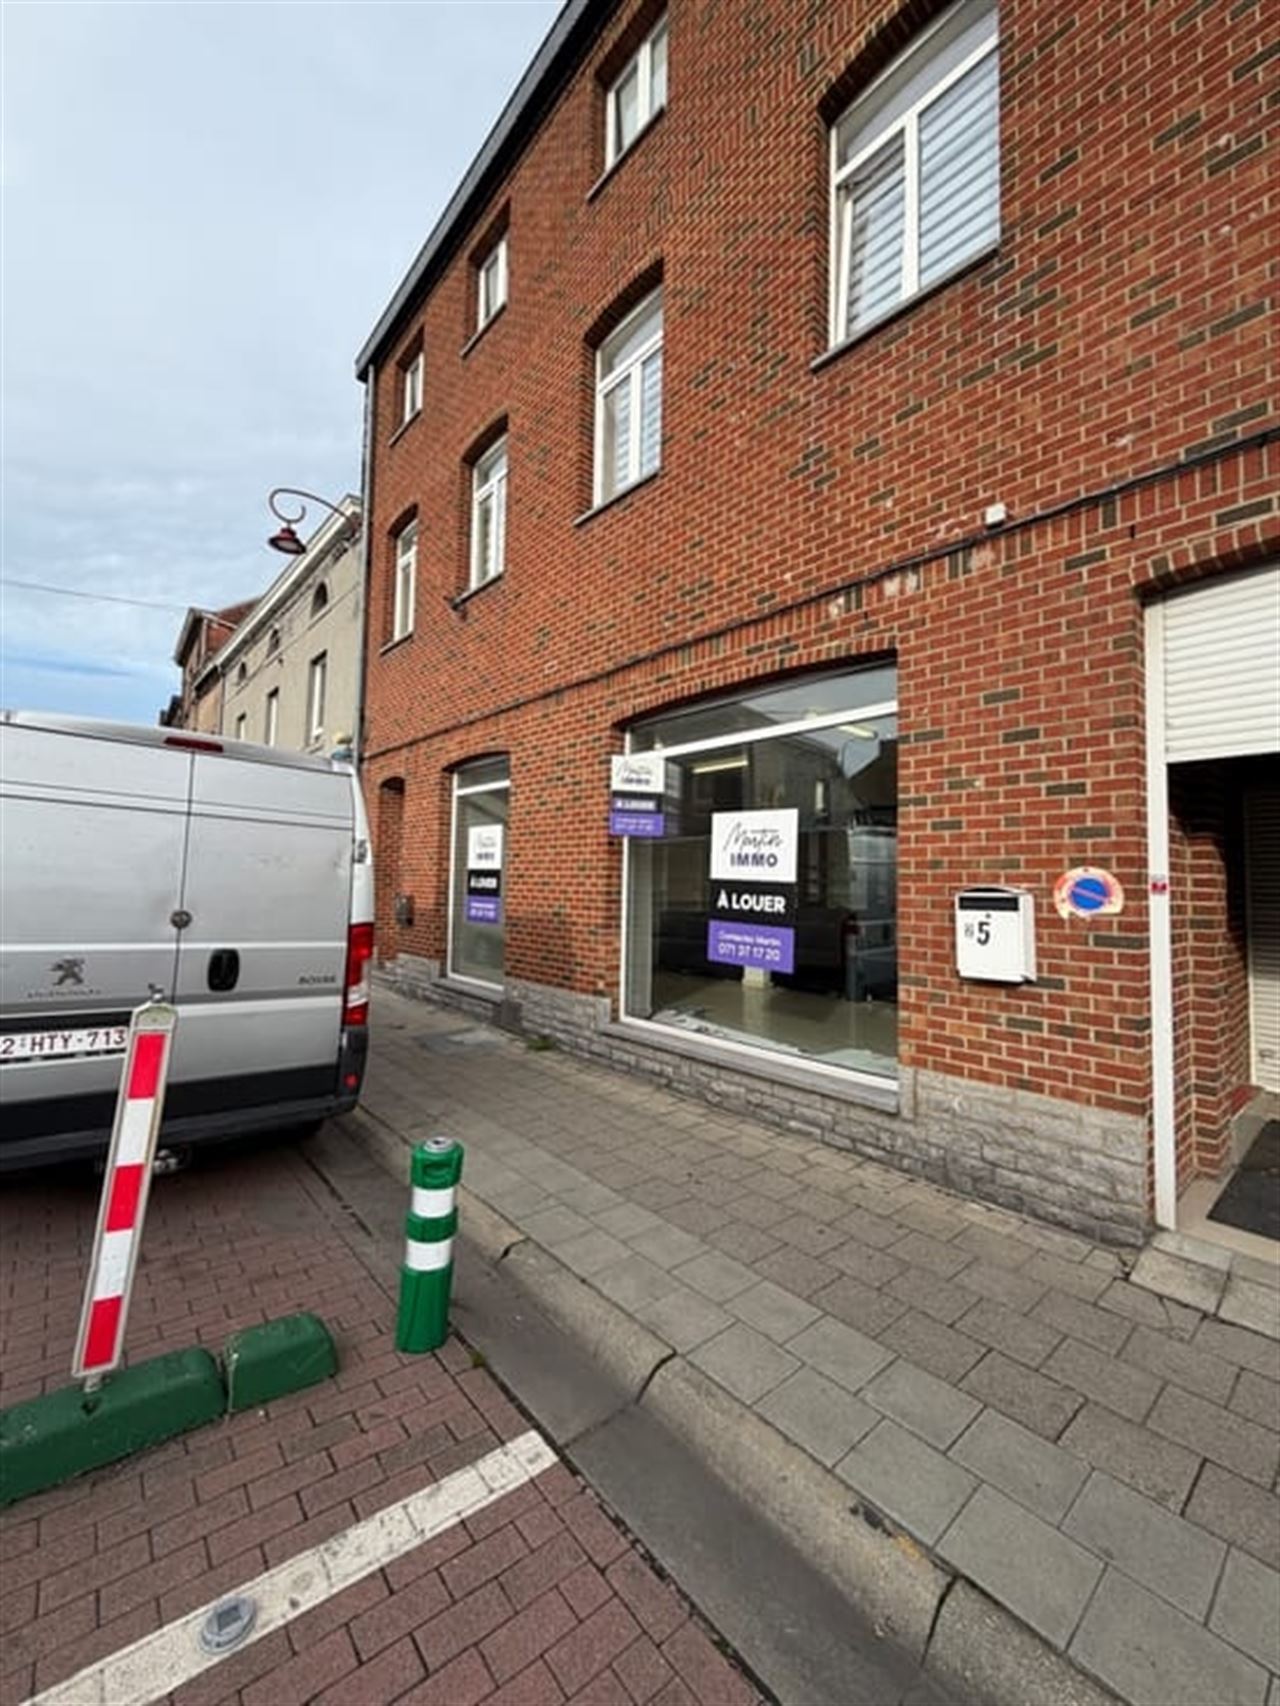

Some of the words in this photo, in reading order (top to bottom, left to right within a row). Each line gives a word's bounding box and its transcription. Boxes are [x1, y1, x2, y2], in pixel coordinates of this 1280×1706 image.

[730, 852, 778, 868] IMMO
[731, 892, 787, 914] LOUER
[976, 921, 991, 946] 5
